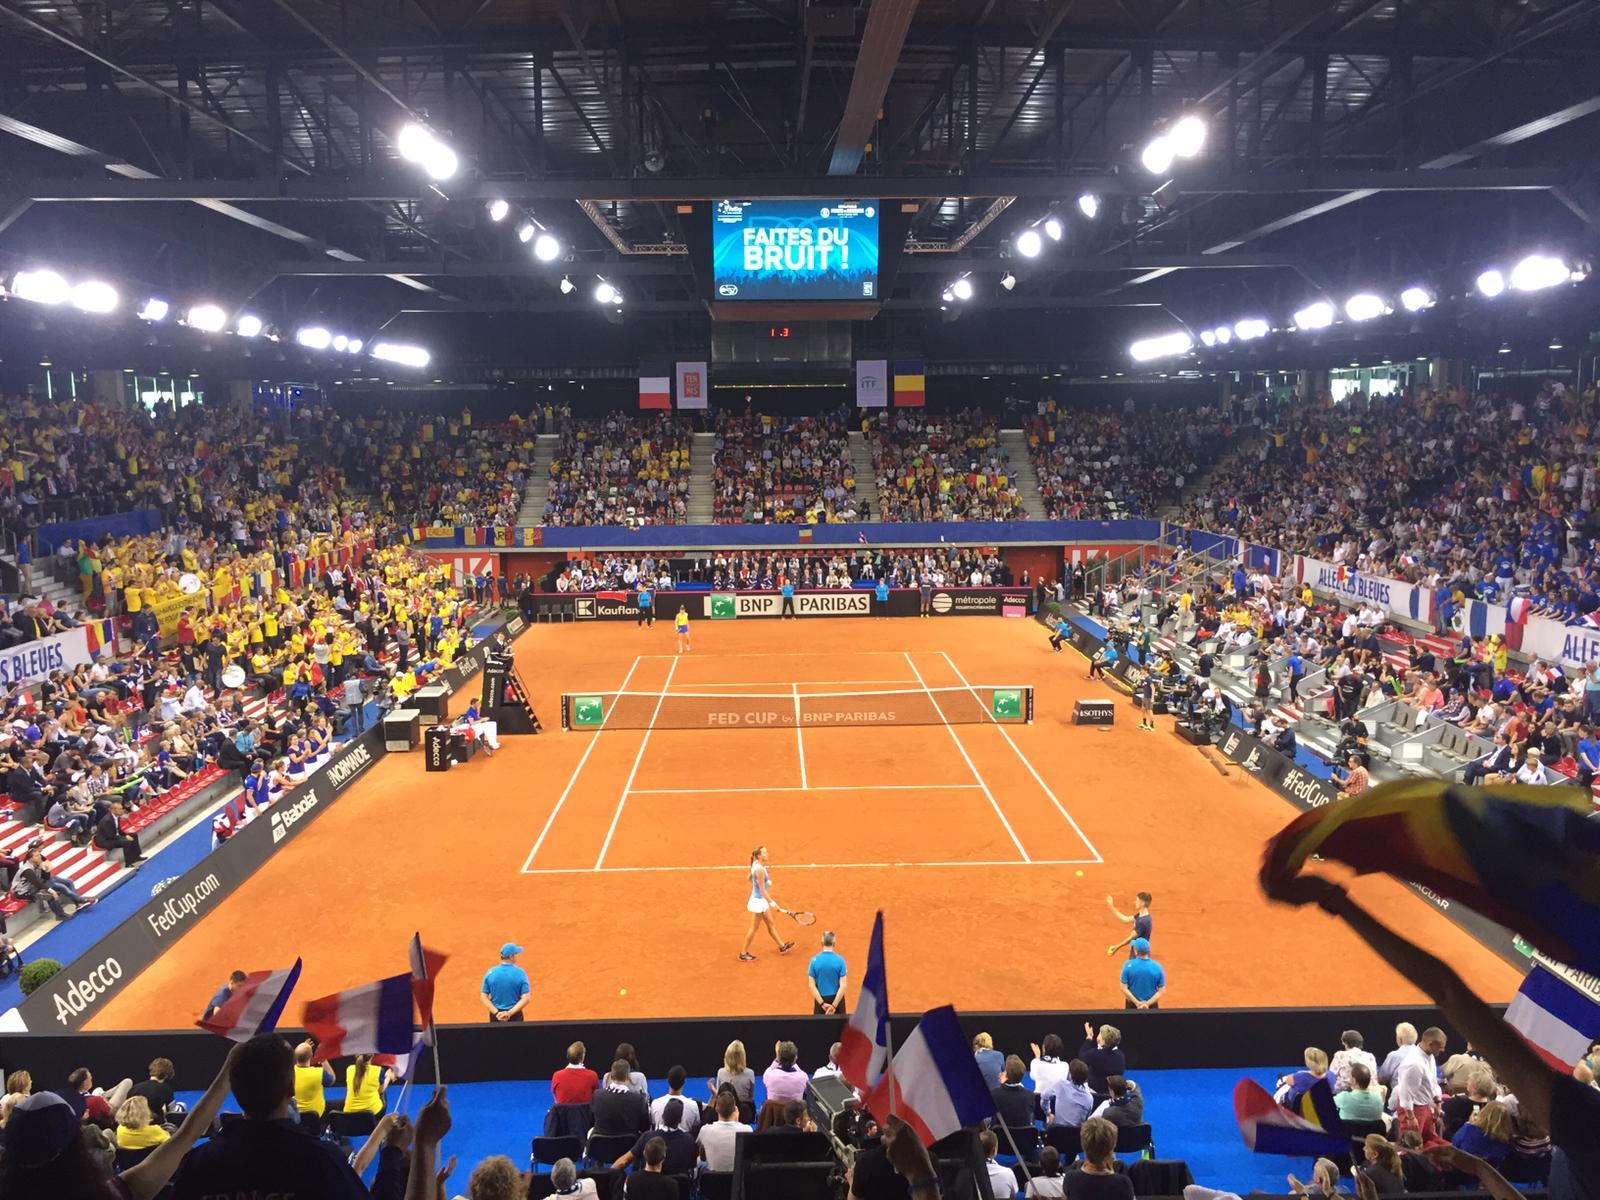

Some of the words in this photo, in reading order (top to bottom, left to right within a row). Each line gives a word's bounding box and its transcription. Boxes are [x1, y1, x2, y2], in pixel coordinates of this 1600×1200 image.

[743, 227, 812, 246] FAITES
[818, 227, 849, 246] DU
[743, 245, 834, 271] BRUIT
[841, 245, 849, 270] !
[955, 595, 997, 605] métropole
[1003, 596, 1026, 604] Adecco
[1359, 577, 1391, 605] BLEUES
[597, 605, 639, 615] Kauflan
[740, 599, 773, 612] BNP
[800, 597, 868, 611] PARIBAS
[12, 642, 63, 682] BLEUES
[708, 712, 740, 725] FED
[744, 712, 778, 724] CUP
[803, 713, 833, 722] BNP
[835, 711, 896, 722] PARIBAS
[1083, 709, 1113, 717] SOTHYS
[432, 736, 440, 767] Adecco
[147, 873, 221, 937] FedCup.com
[53, 957, 122, 1026] Adecco
